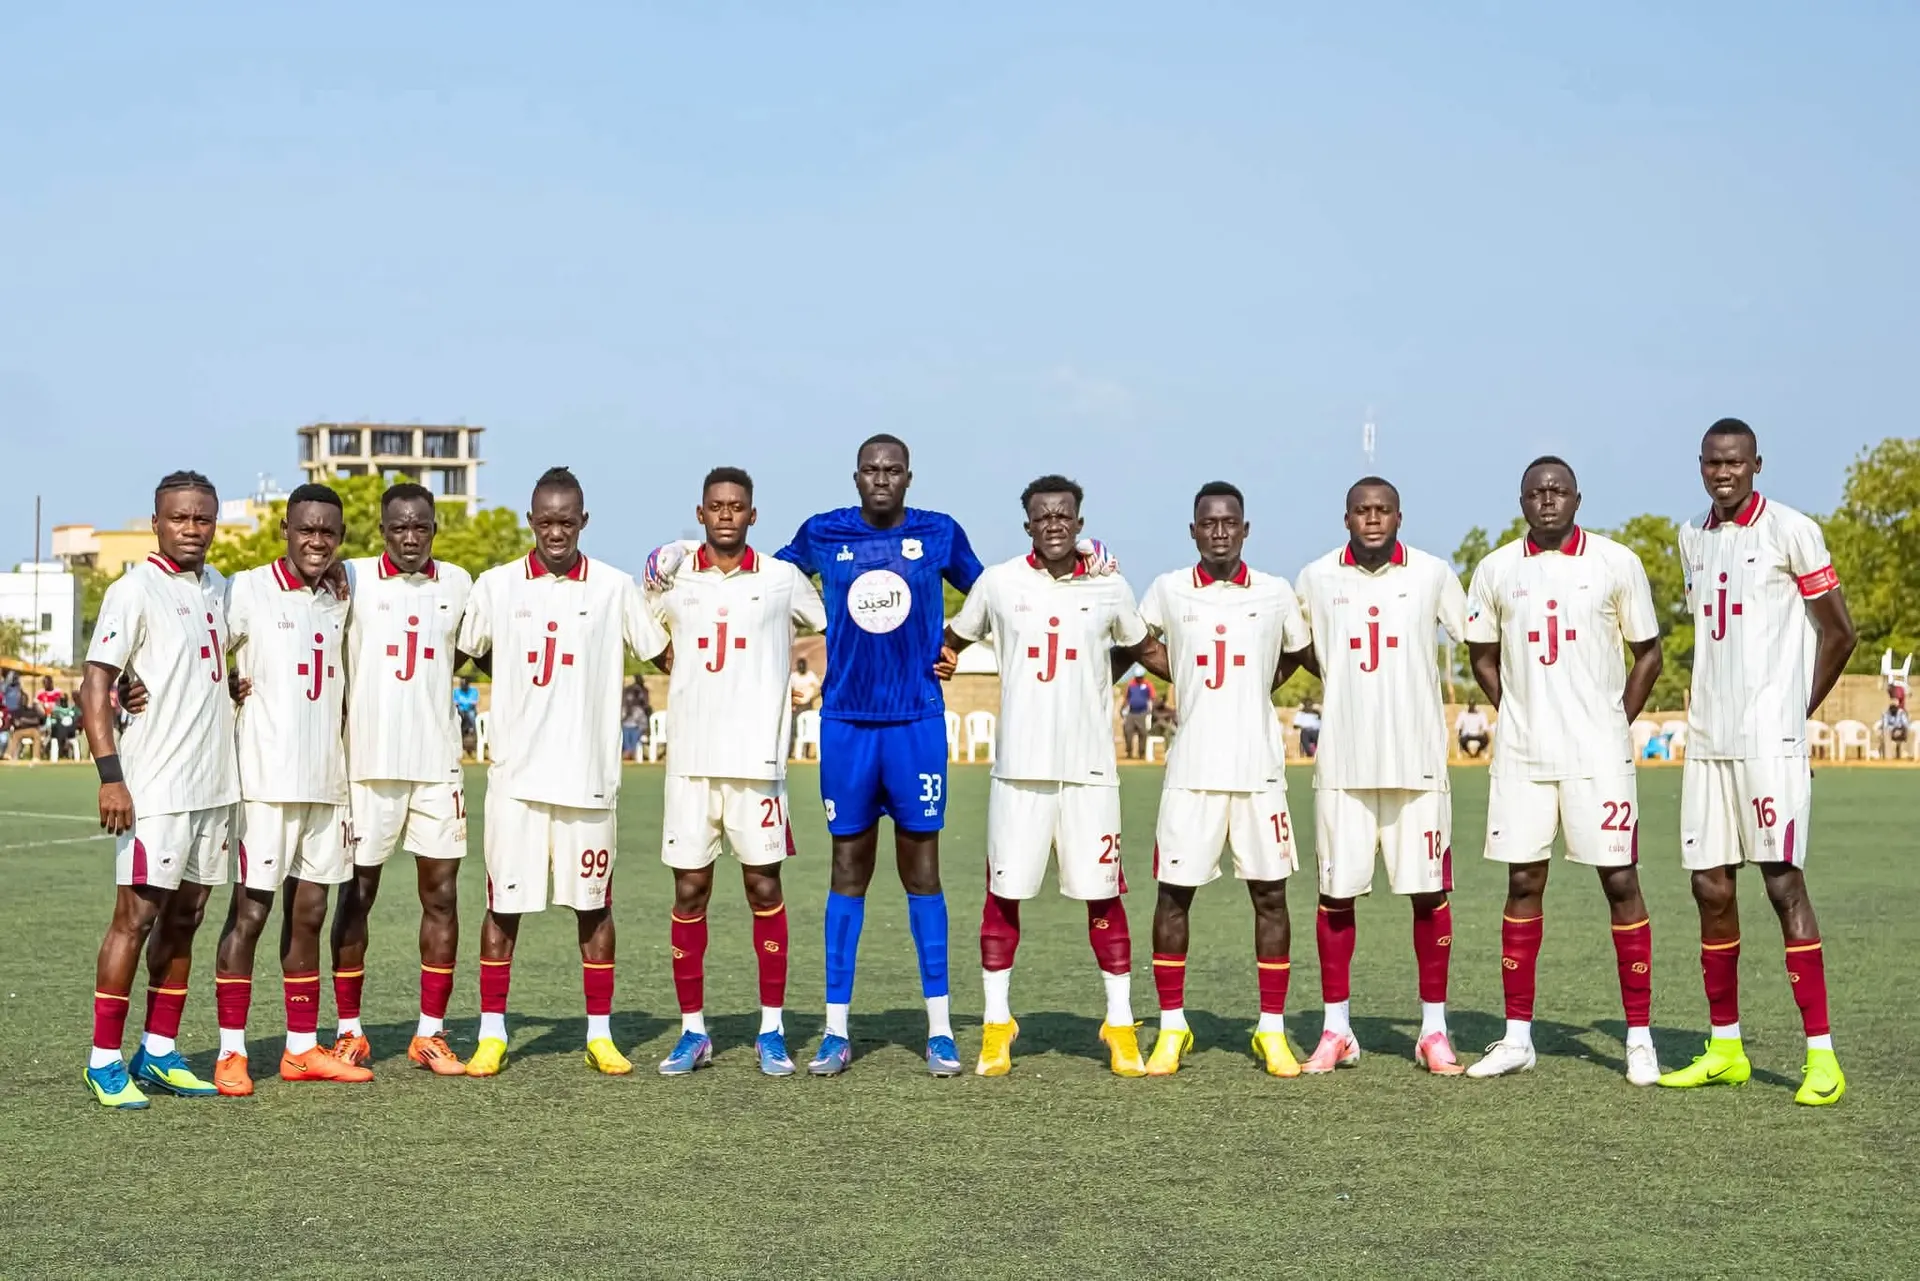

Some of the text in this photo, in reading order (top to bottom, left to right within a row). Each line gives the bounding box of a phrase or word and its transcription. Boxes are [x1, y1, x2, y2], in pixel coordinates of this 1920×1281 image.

[918, 772, 943, 802] 33
[760, 796, 784, 829] 21
[1270, 811, 1291, 844] 15
[1600, 800, 1633, 832] 22
[1752, 795, 1778, 829] 16
[1098, 833, 1122, 865] 25
[1423, 830, 1443, 861] 18
[580, 848, 610, 880] 99
